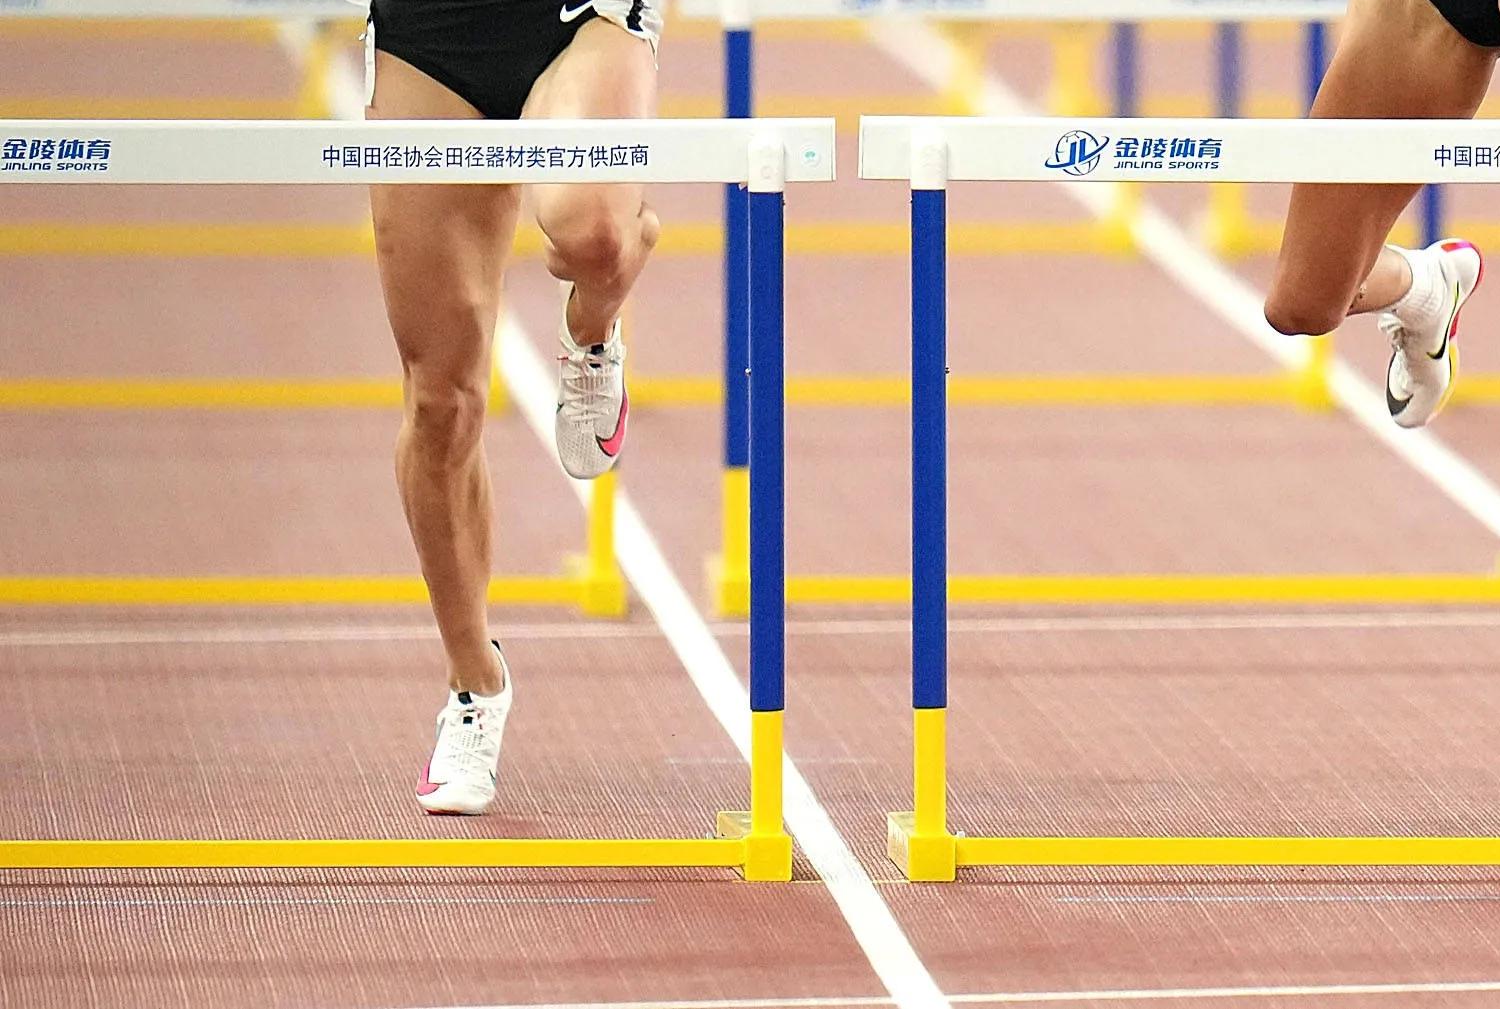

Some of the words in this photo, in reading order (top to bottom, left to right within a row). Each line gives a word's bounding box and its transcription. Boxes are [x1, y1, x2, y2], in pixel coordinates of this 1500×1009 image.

[1, 138, 112, 160] 金陵体育
[322, 144, 649, 168] 中国田径协会田径器材类官方供应商
[1113, 137, 1223, 159] 金陵体育
[1, 162, 52, 171] JINLING
[56, 162, 108, 171] SPORTS
[1113, 161, 1163, 169] JINLING
[1168, 161, 1219, 170] SPORTS
